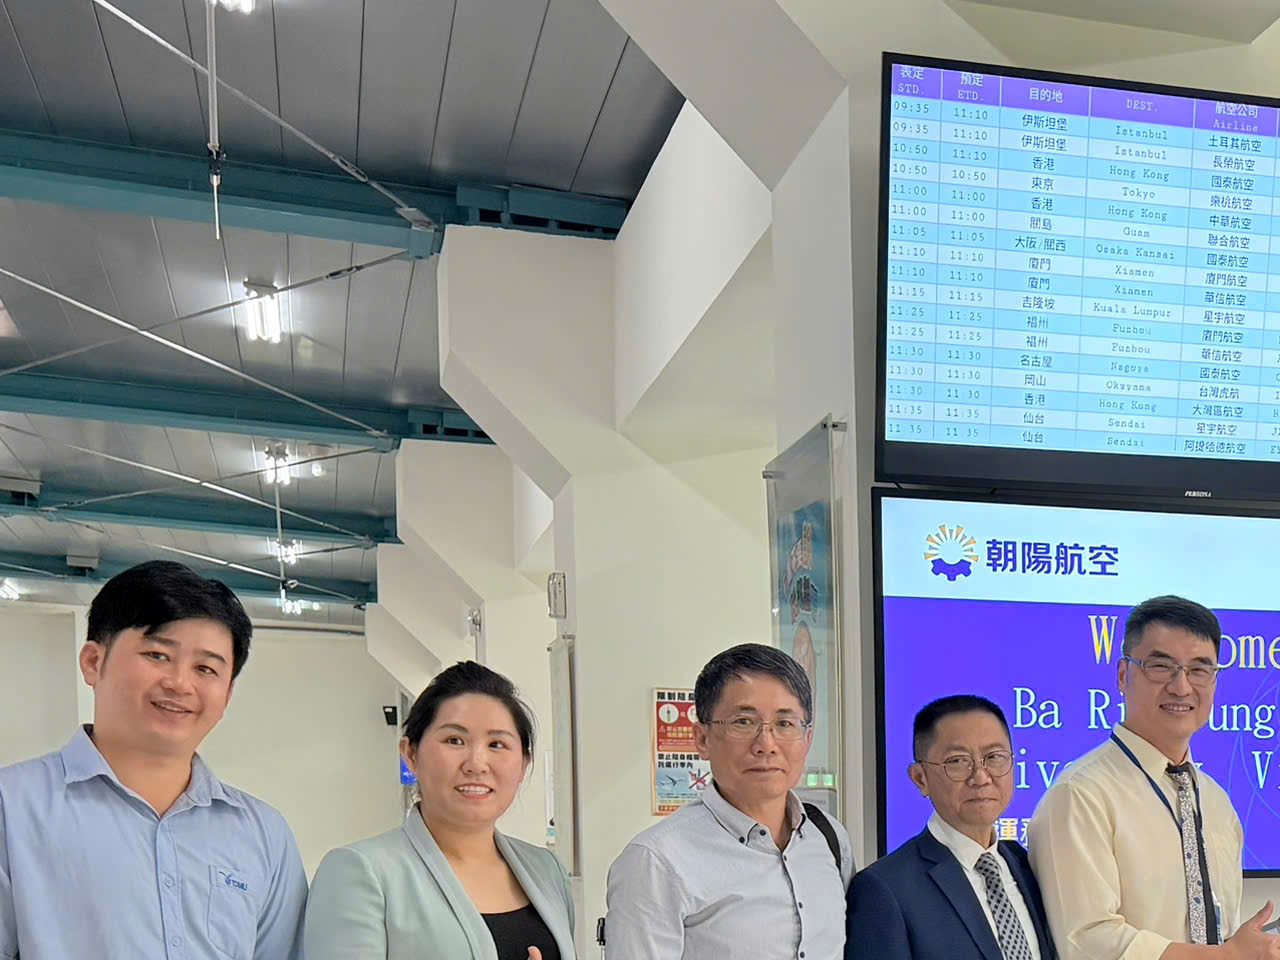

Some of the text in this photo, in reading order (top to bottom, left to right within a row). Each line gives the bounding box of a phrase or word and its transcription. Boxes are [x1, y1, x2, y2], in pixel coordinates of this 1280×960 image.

[960, 72, 983, 86] 預定
[1029, 87, 1063, 103] 目的地
[1125, 99, 1158, 111] DEST.
[1215, 101, 1258, 118] 航空公司
[893, 100, 929, 114] 09:35
[953, 107, 988, 120] 11:10
[1022, 113, 1068, 131] 伊斯坦堡
[1115, 125, 1168, 140] Istanbul
[1208, 134, 1262, 152] 土耳其航空
[893, 121, 928, 134] 09:35
[953, 128, 987, 141] 11:10
[1021, 134, 1067, 151] 伊斯坦堡
[1114, 145, 1167, 160] Istanbul
[1212, 155, 1255, 171] 長榮航空
[1213, 119, 1258, 132] Airline
[892, 163, 927, 176] 10:50
[952, 169, 986, 182] 10:50
[1031, 176, 1053, 191] 東京
[1121, 186, 1155, 200] Tokyo
[893, 142, 928, 155] 10:50
[952, 148, 986, 161] 11:10
[1032, 156, 1054, 170] 香港
[1109, 165, 1136, 179] Hong
[1143, 168, 1169, 182] Kong
[1211, 174, 1253, 191] 國泰航空
[892, 184, 927, 196] 11:00
[951, 190, 985, 202] 11:00
[1030, 197, 1053, 211] 香港
[1107, 205, 1134, 218] Hong
[1140, 208, 1167, 221] Kong
[1209, 214, 1251, 230] 中華航空
[892, 204, 926, 217] 11:00
[951, 210, 985, 222] 11:00
[1122, 226, 1150, 238] Guam
[1207, 233, 1249, 249] 聯合航空
[891, 225, 926, 237] 11:05
[950, 230, 984, 242] 11:05
[1206, 253, 1248, 268] 國泰航空
[891, 245, 926, 257] 11:10
[950, 250, 983, 262] 11:10
[1028, 257, 1050, 270] 廈門
[1115, 265, 1154, 277] Xiamen
[1205, 272, 1247, 287] 廈門航空
[891, 265, 925, 277] 11:10
[949, 270, 983, 282] 11:10
[1027, 276, 1049, 290] 廈門
[1114, 285, 1153, 297] Xiamen
[1204, 291, 1245, 306] 華信航空
[986, 538, 1119, 576] 朝陽航空
[1013, 687, 1062, 730] Ba
[1208, 695, 1277, 739] ung
